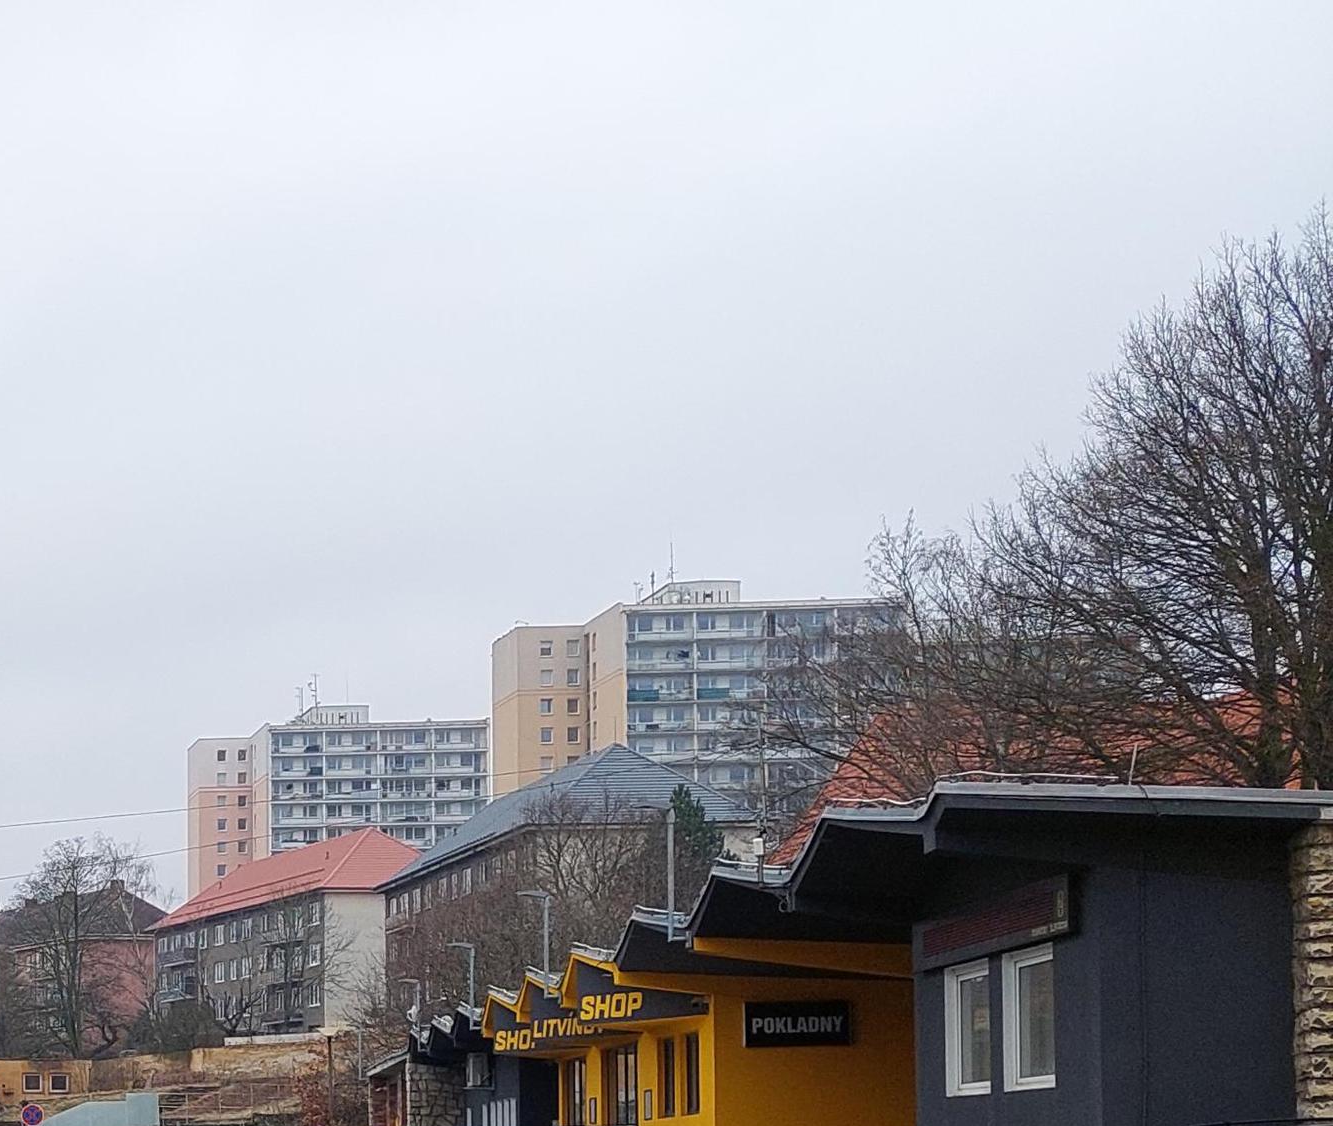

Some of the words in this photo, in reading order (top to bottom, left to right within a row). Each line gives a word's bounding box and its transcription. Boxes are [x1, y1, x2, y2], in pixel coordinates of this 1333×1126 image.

[580, 992, 643, 1020] SHOP
[751, 1016, 844, 1034] POKLADNY
[494, 1029, 536, 1051] SHO
